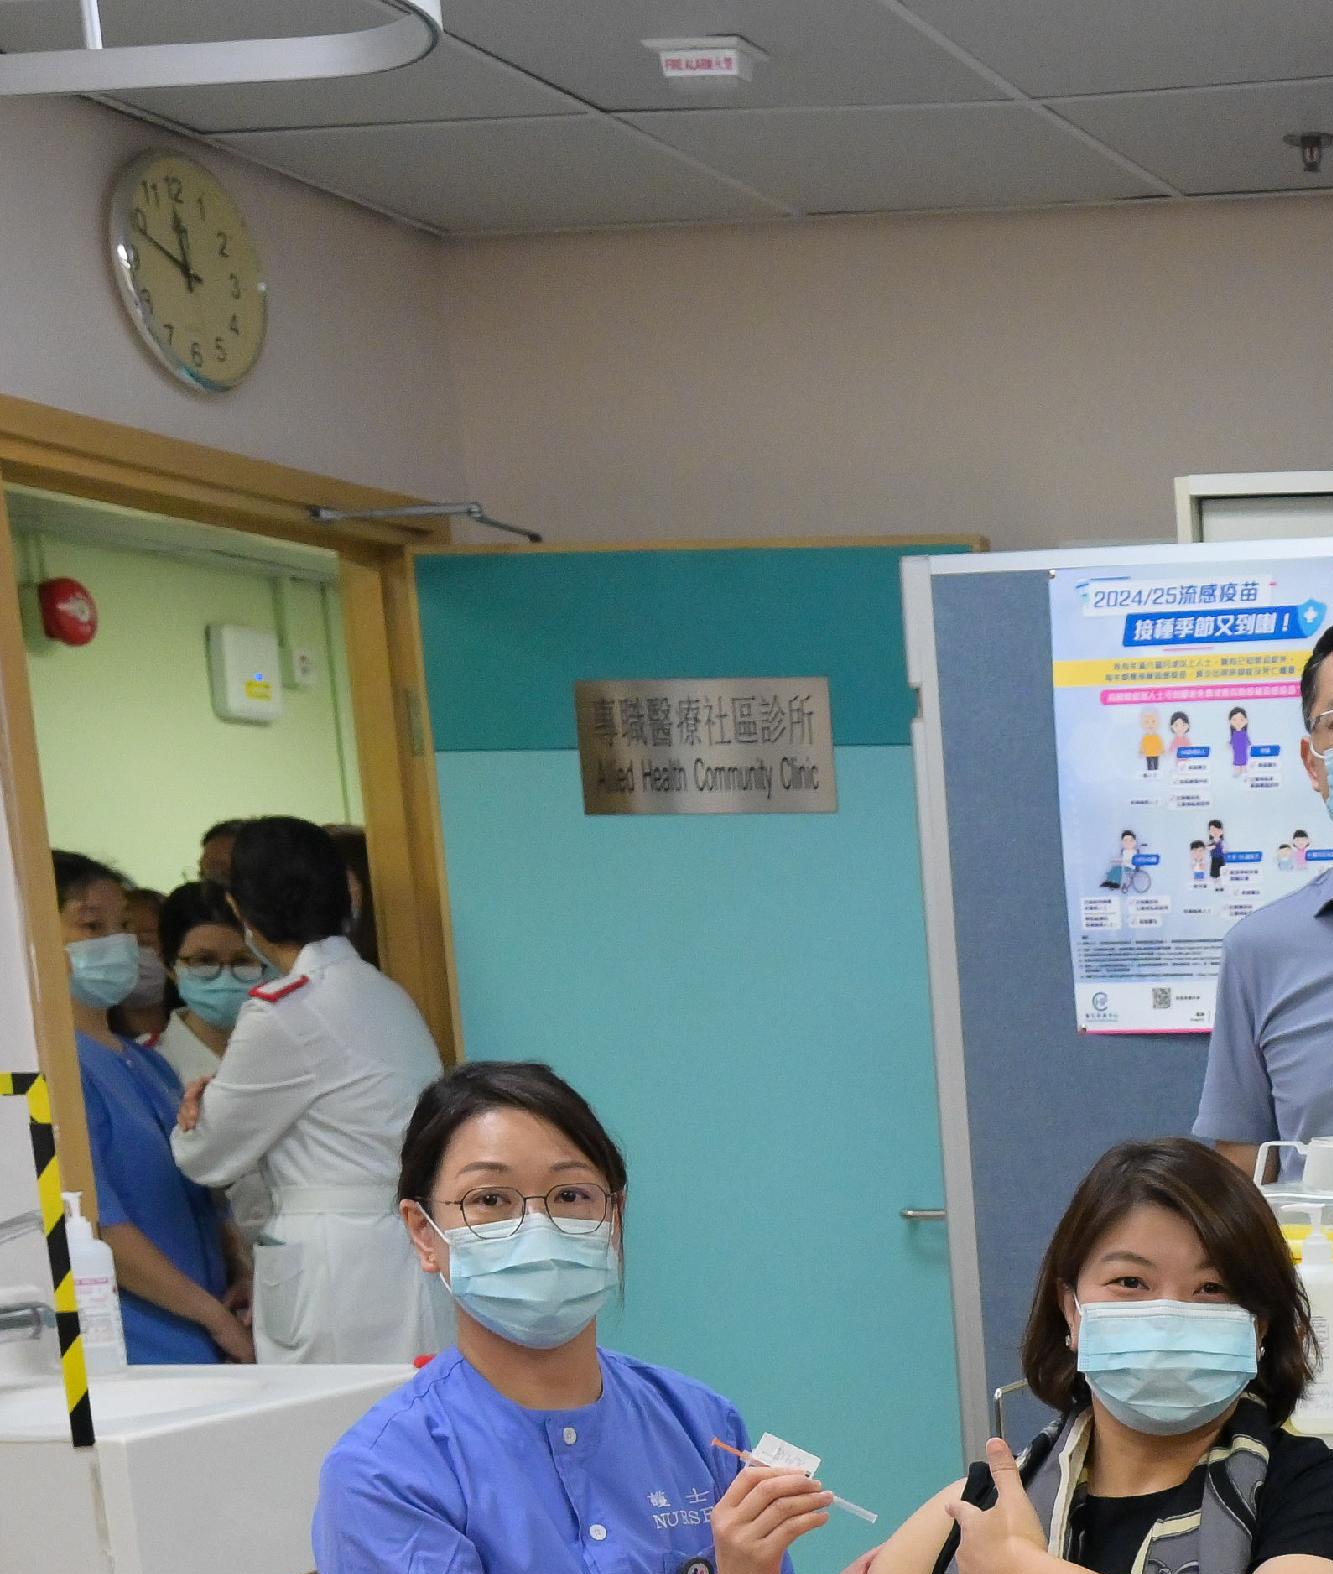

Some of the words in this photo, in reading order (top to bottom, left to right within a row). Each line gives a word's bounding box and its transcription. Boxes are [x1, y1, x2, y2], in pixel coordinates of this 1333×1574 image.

[640, 757, 688, 793] Health
[693, 756, 773, 800] Community
[780, 756, 820, 791] Clinic
